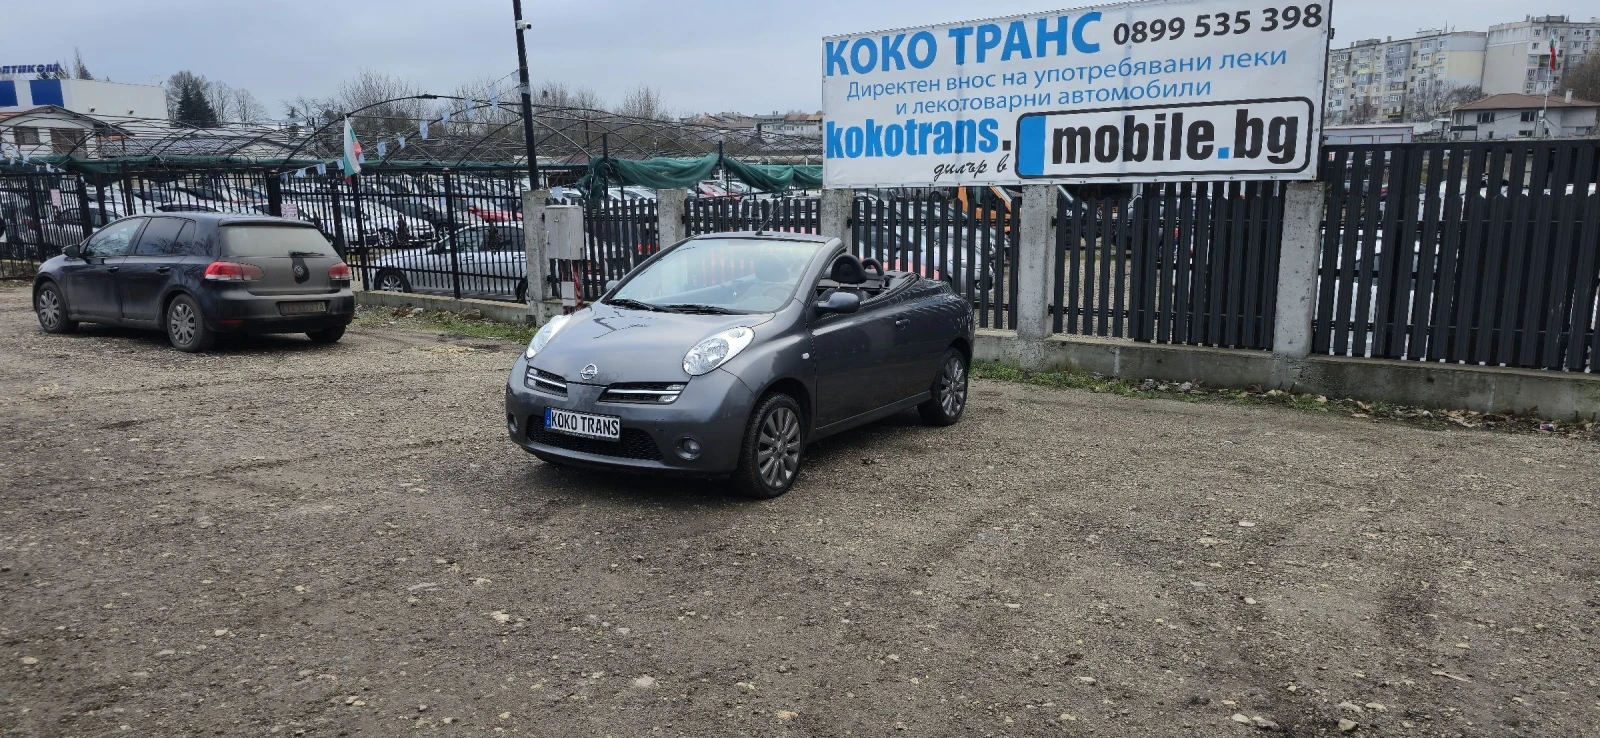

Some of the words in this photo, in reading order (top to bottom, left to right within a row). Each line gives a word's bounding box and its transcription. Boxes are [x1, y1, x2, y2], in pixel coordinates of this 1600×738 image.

[826, 31, 937, 76] КОКО
[948, 11, 1102, 65] ТРАНС
[1113, 17, 1185, 45] 0899
[1193, 10, 1251, 38] 535
[1260, 3, 1322, 32] 398
[847, 78, 940, 100] Директен
[946, 73, 996, 90] внос
[1002, 70, 1027, 85] на
[1034, 56, 1211, 89] употребявани
[1219, 50, 1287, 70] леки
[896, 103, 907, 115] и
[912, 93, 1050, 115] лекотоварни
[1058, 78, 1211, 105] автомобили
[826, 118, 1011, 159] kokotrans.
[1052, 109, 1298, 164] mobile.bg
[933, 159, 988, 182] дилър
[996, 154, 1010, 174] в
[551, 411, 577, 429] KOKO
[580, 417, 619, 436] TRANS
